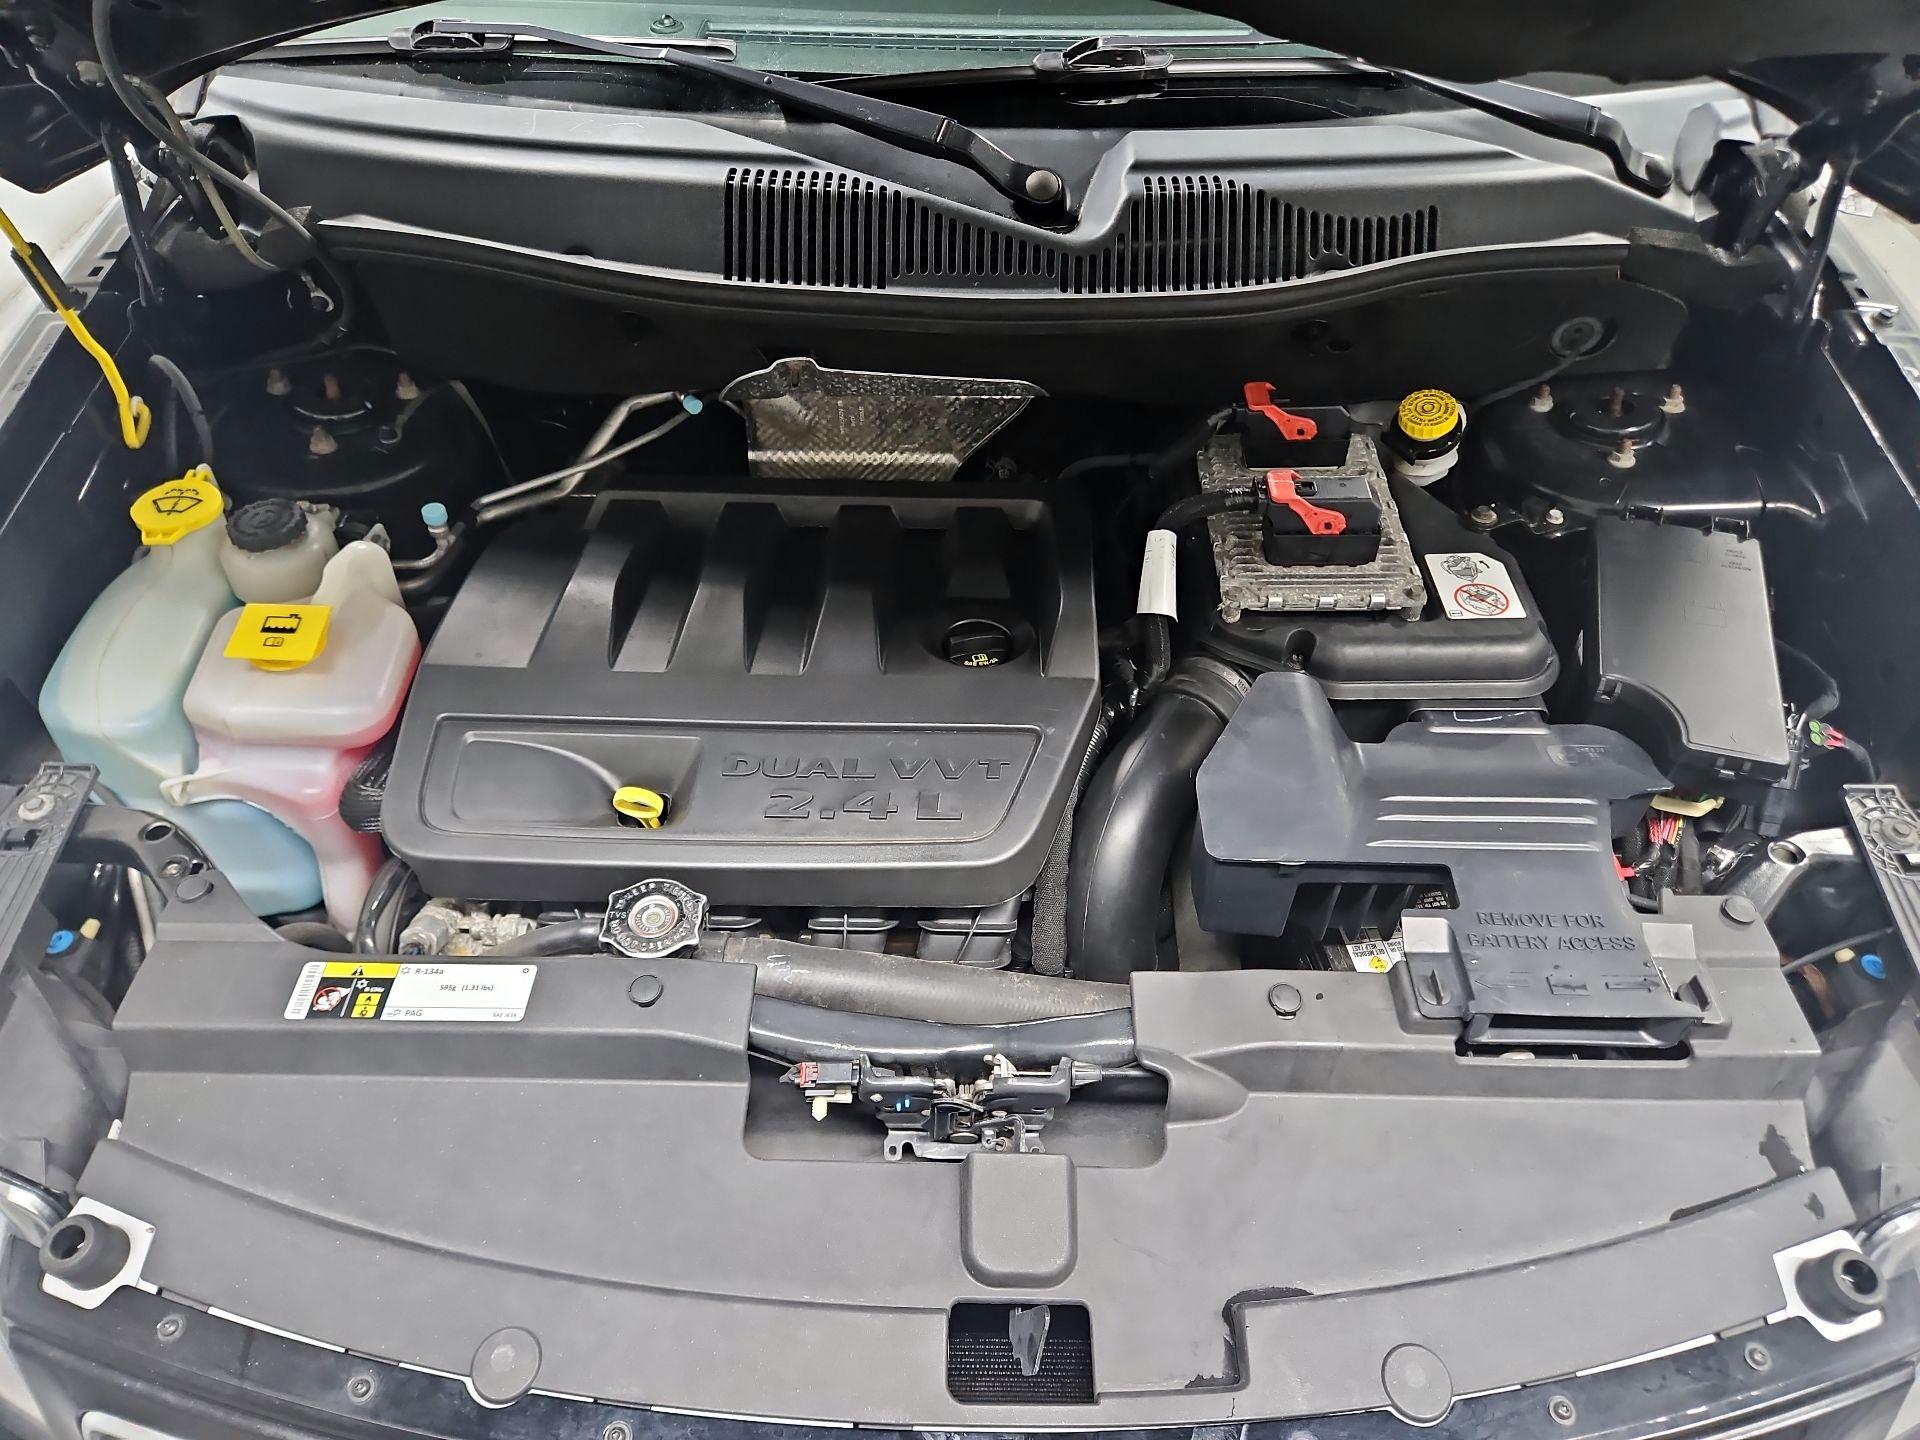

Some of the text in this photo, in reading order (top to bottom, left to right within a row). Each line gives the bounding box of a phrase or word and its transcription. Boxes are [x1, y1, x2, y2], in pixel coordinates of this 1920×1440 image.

[722, 753, 1011, 780] DUAL VVT
[609, 911, 627, 919] TVS
[1476, 911, 1606, 928] REMOVE FOR
[1467, 933, 1637, 951] BATTERY ACCESS
[440, 984, 494, 992] 595g (1.31 lbs)
[404, 1009, 423, 1017] PAG
